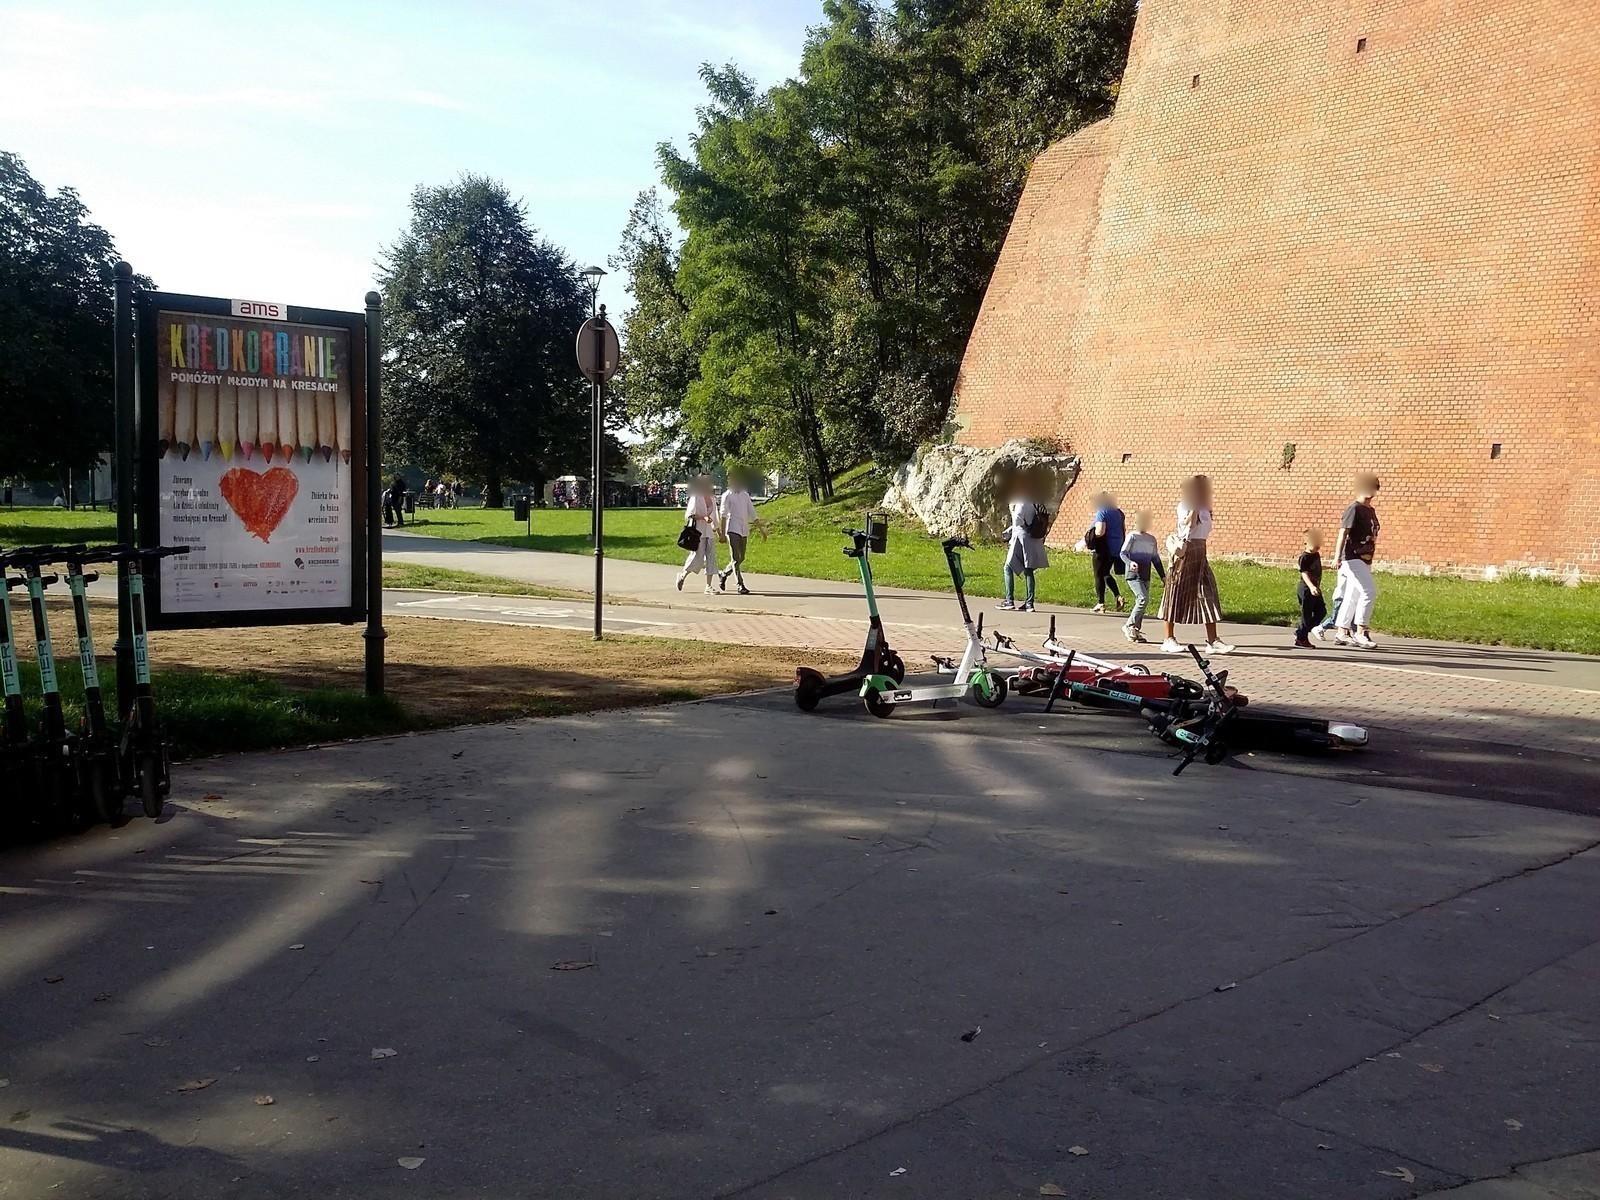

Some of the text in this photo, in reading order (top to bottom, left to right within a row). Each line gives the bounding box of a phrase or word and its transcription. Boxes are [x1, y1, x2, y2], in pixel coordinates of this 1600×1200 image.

[240, 302, 279, 317] ams
[170, 324, 338, 379] KREDKOBRANIE
[171, 371, 338, 393] POMÓŻMY MŁODYM NA KRESACH!
[1, 644, 15, 689] TIER
[38, 643, 52, 690] TIER
[80, 639, 94, 684] TIER
[135, 637, 148, 681] TIER
